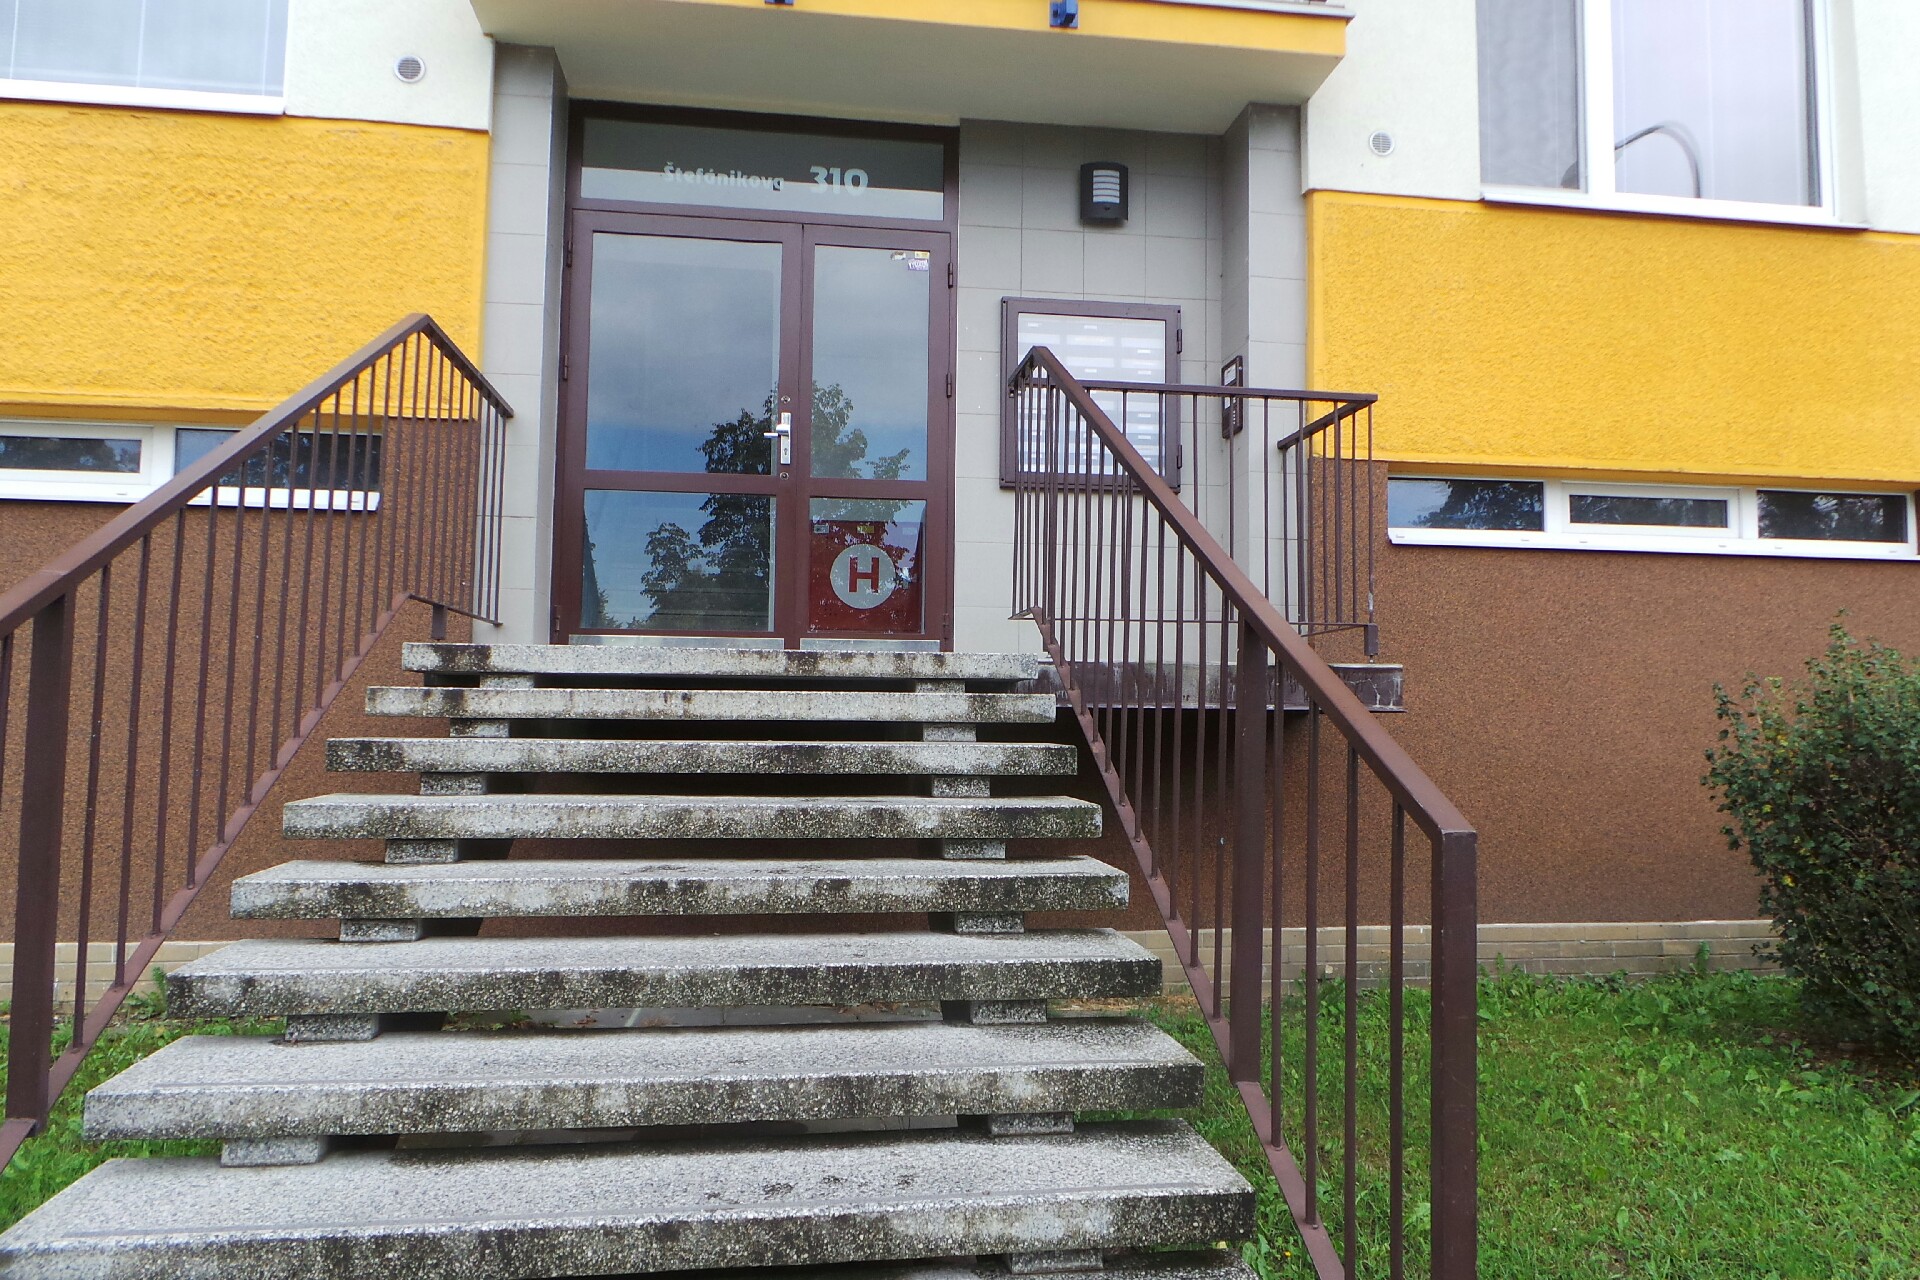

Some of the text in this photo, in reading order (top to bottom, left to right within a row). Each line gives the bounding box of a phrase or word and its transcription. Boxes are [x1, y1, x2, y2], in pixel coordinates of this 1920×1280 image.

[663, 161, 869, 196] Štefánikova 310
[848, 556, 880, 593] H
